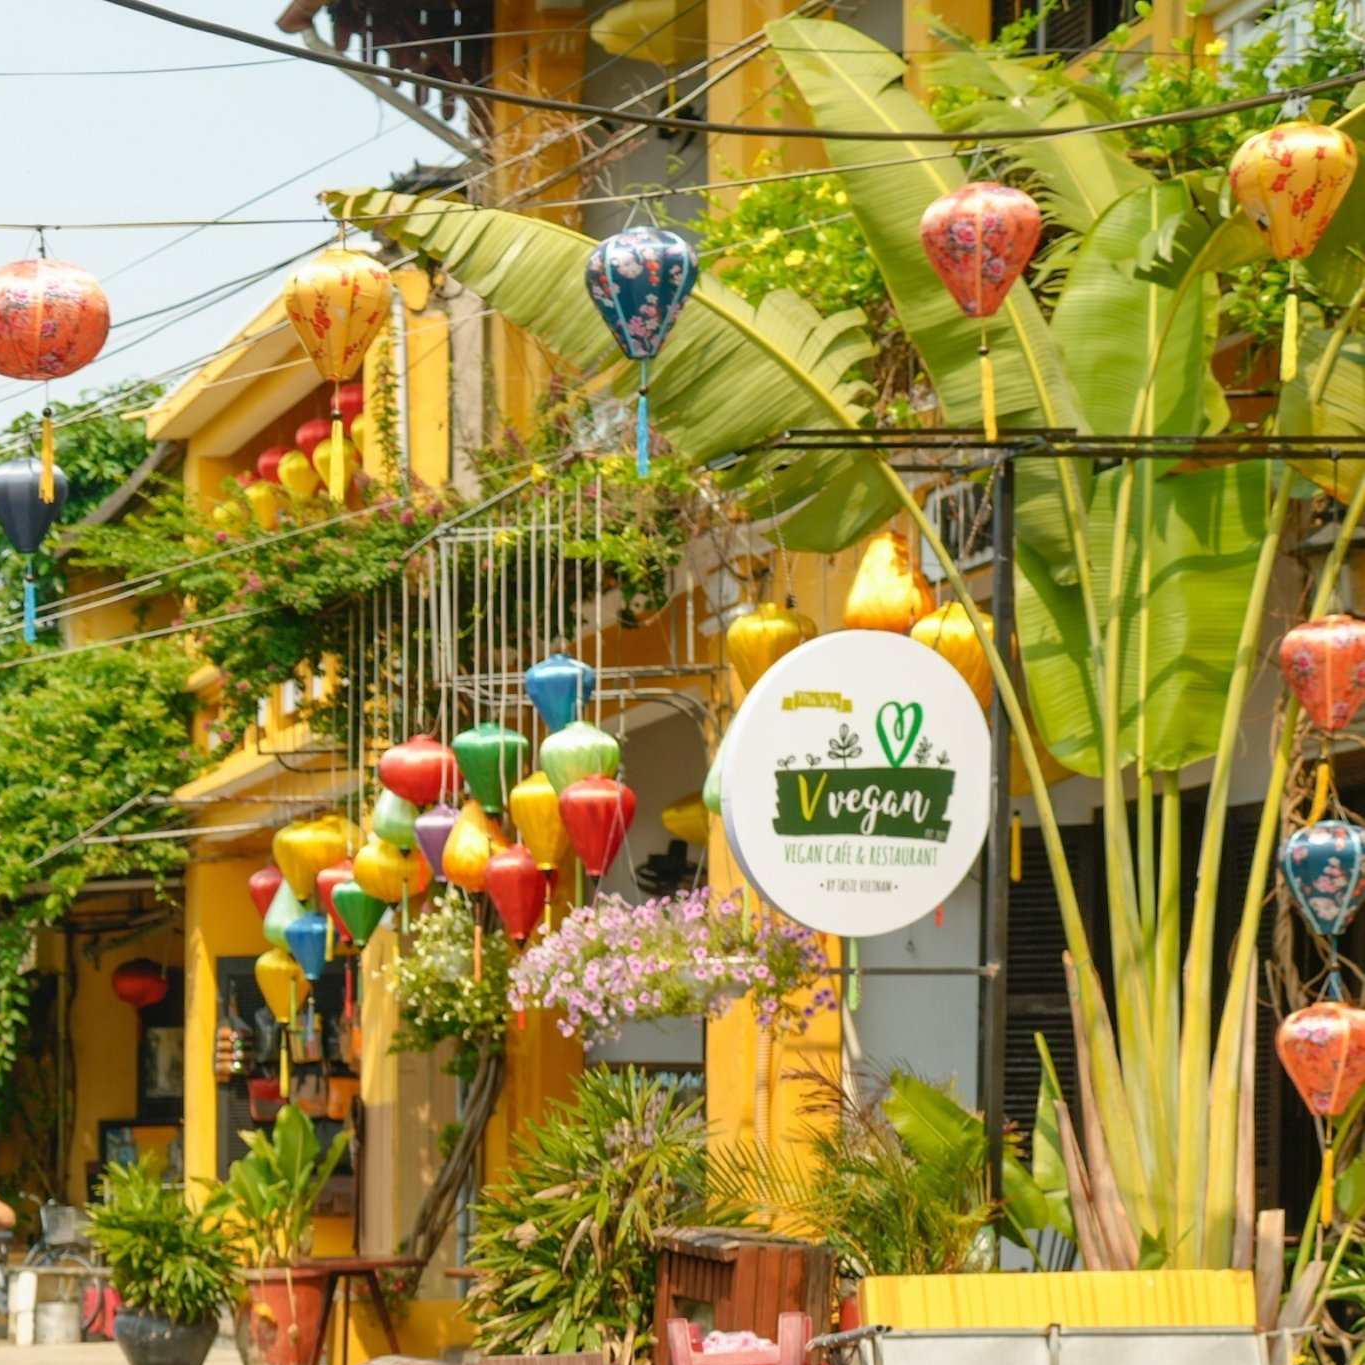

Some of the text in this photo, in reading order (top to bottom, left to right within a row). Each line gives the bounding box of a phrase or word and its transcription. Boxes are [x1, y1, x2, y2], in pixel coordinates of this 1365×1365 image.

[828, 784, 931, 835] vegan
[784, 843, 821, 864] VEGAN
[855, 846, 865, 865] &
[869, 845, 938, 866] RESTAURANT
